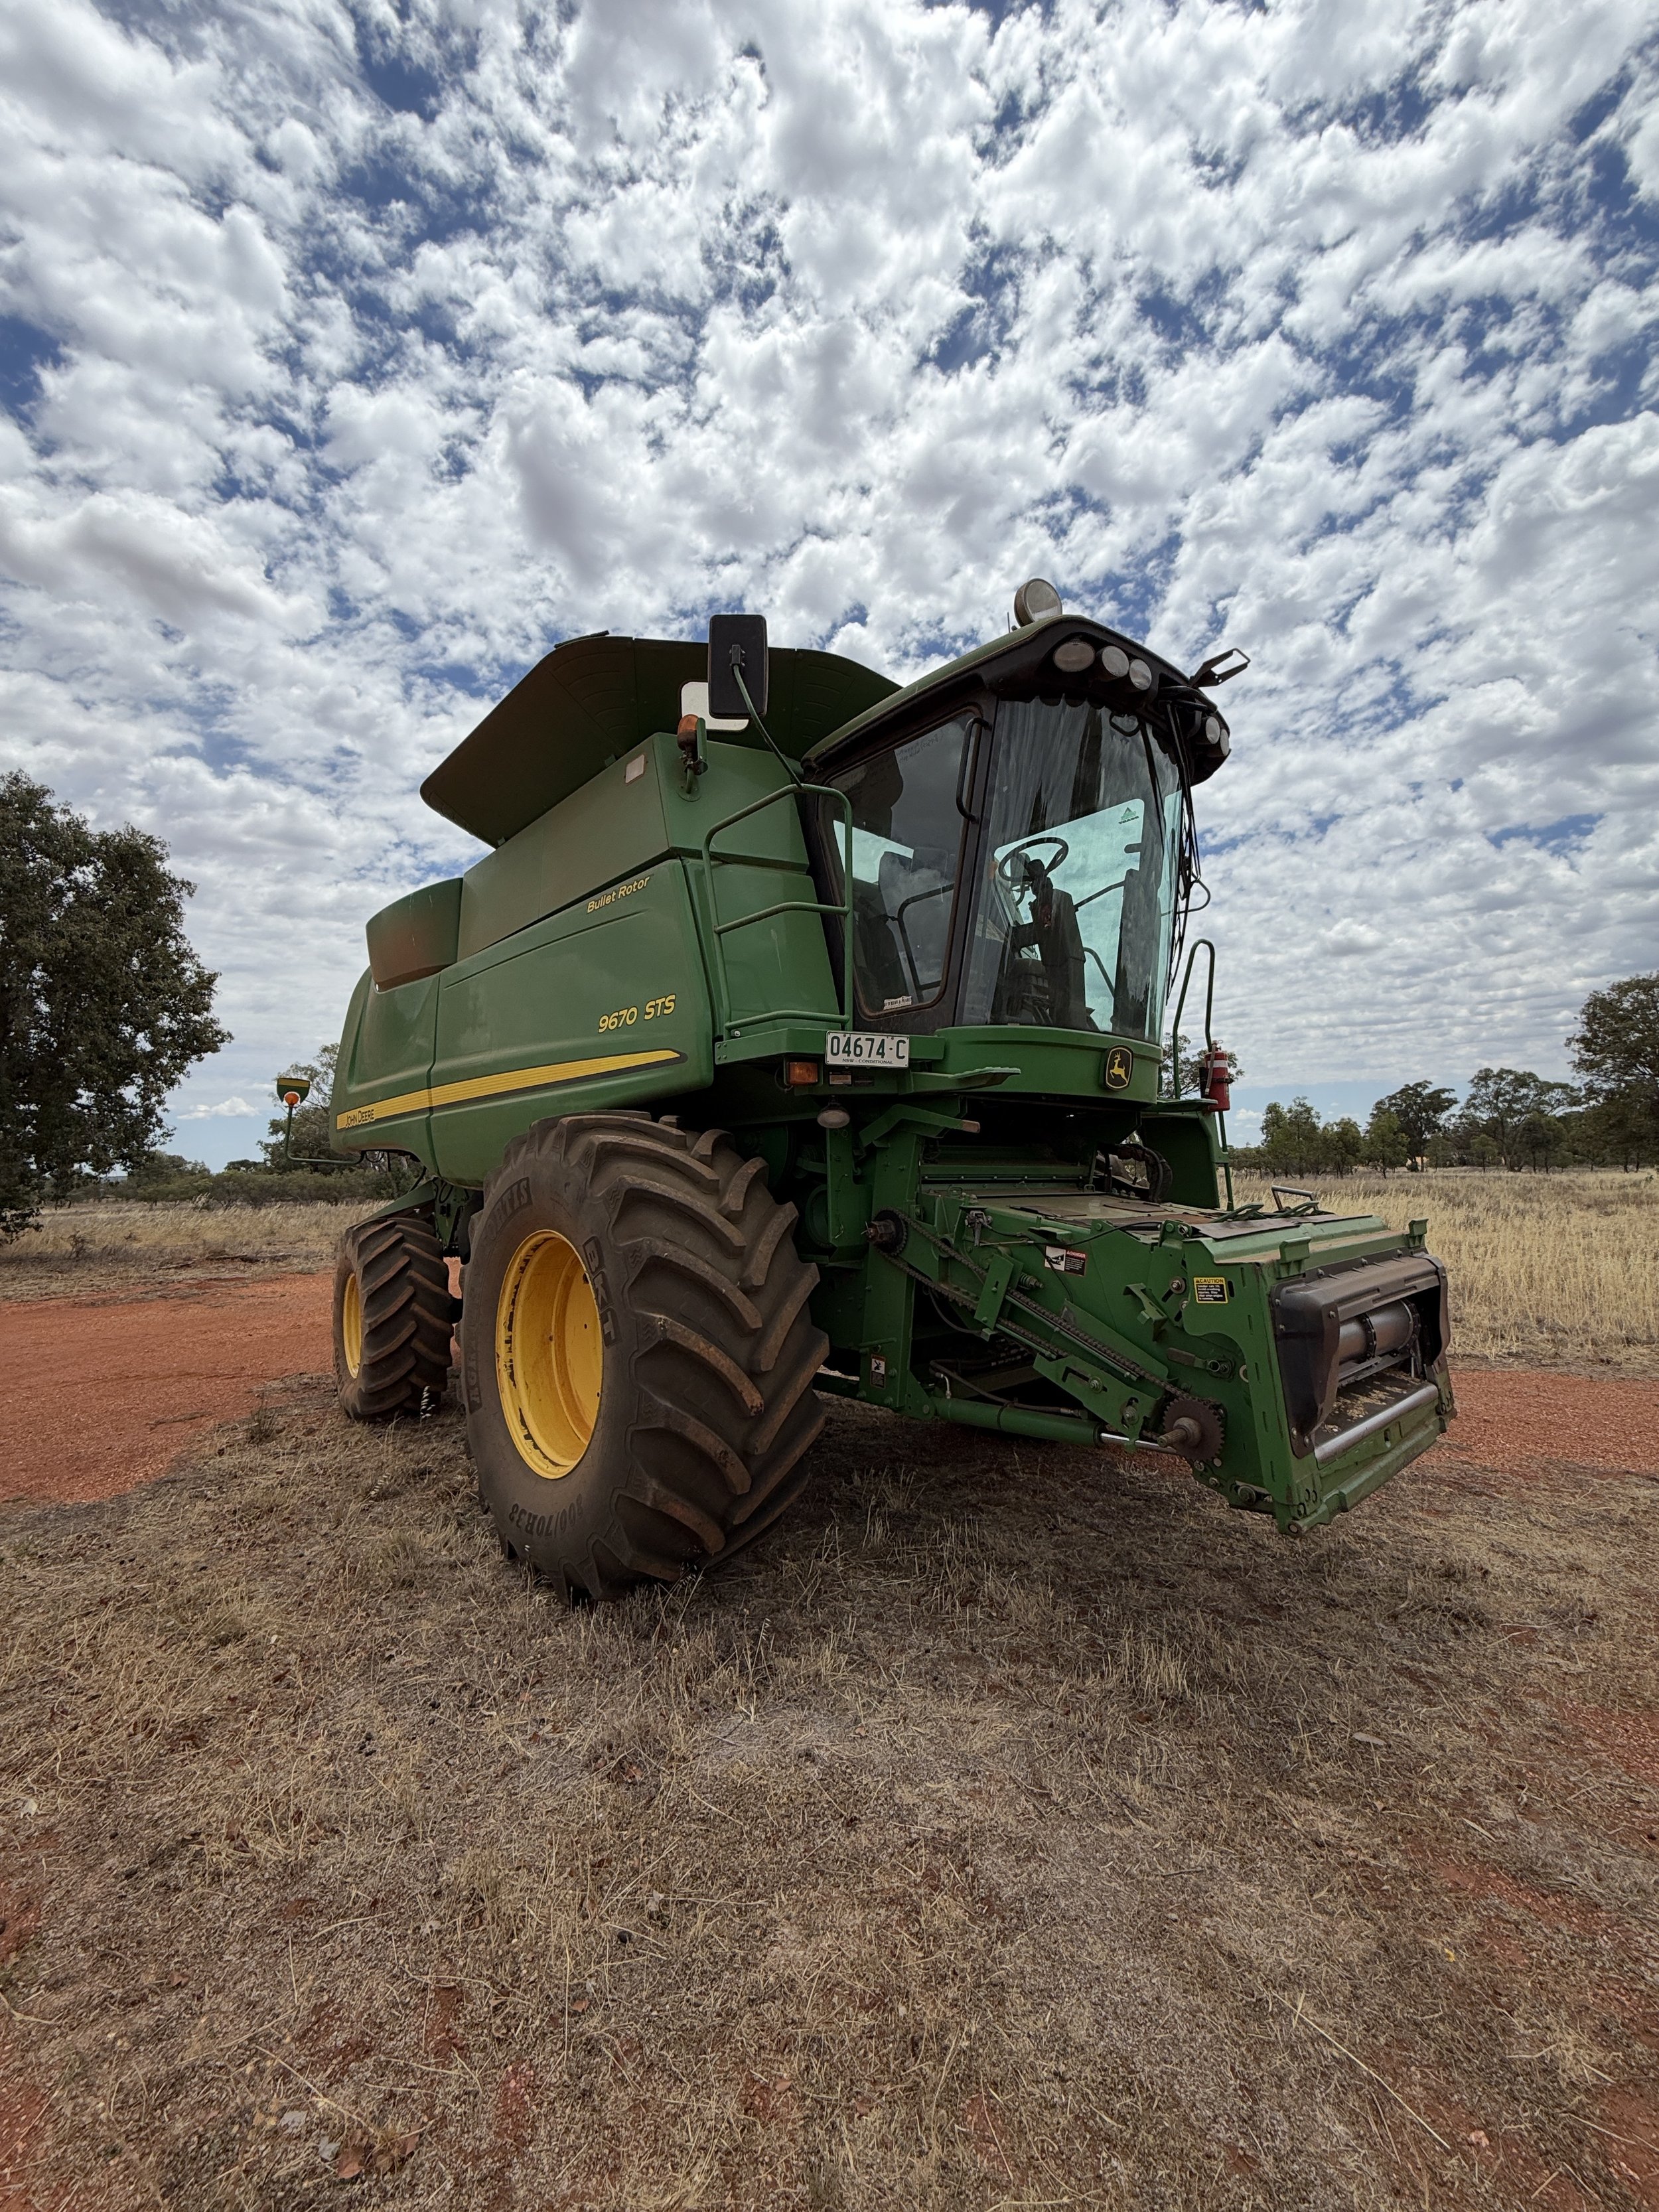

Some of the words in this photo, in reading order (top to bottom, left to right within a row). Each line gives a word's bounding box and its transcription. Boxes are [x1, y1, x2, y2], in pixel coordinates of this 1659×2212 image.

[587, 891, 617, 914] Bullet
[618, 875, 651, 900] Rotor
[598, 1005, 638, 1033] 9670
[643, 994, 676, 1021] STS
[345, 1113, 358, 1127] JOHN
[358, 1109, 374, 1124] DEERE
[583, 1238, 618, 1345] BKT
